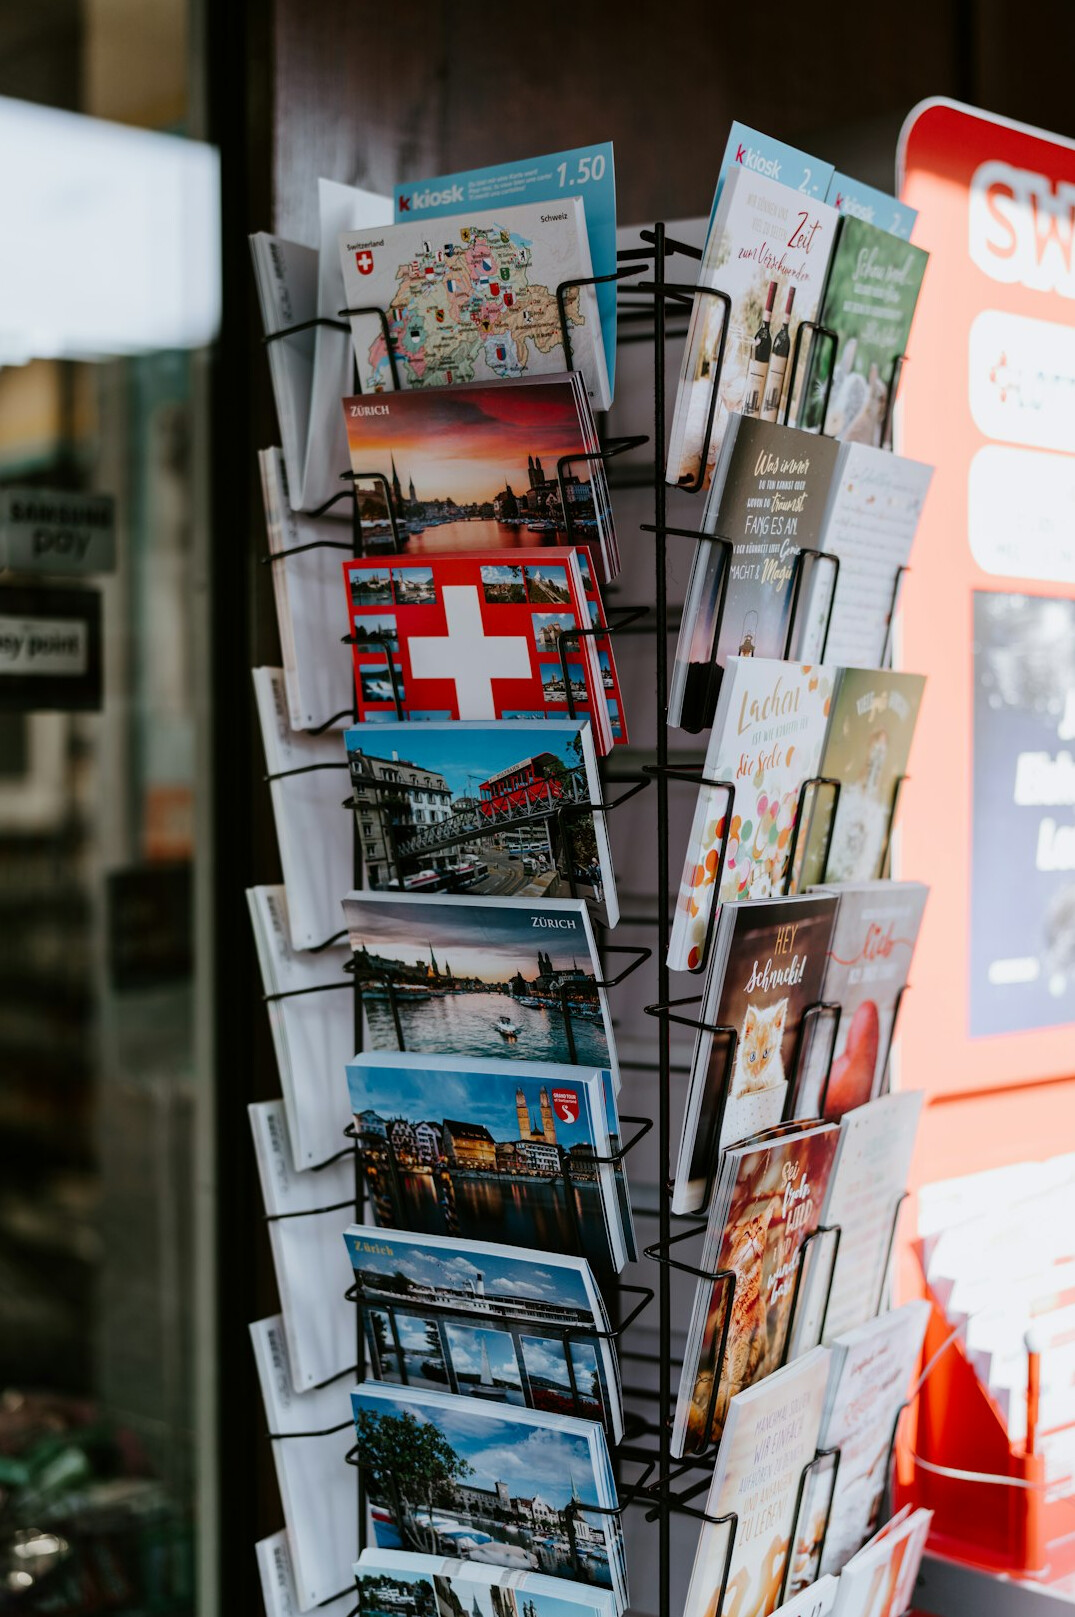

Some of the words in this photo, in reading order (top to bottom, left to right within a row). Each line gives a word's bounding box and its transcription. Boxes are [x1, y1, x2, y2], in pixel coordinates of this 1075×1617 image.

[557, 155, 605, 188] 1.50
[413, 184, 465, 210] kiosk
[540, 212, 568, 223] Schweiz
[347, 239, 385, 251] Switzerland
[787, 212, 822, 254] Zeit
[350, 404, 389, 417] ZÜRICH
[754, 449, 780, 476] Was
[780, 458, 810, 475] immer
[745, 515, 770, 537] FANG
[770, 516, 784, 535] ES
[730, 564, 755, 580] MACHT
[738, 676, 801, 736] Lachen
[531, 916, 577, 930] ZÜRICH
[774, 924, 799, 956] HEY
[743, 955, 808, 993] Schnucki!
[354, 1240, 394, 1256] Zürich
